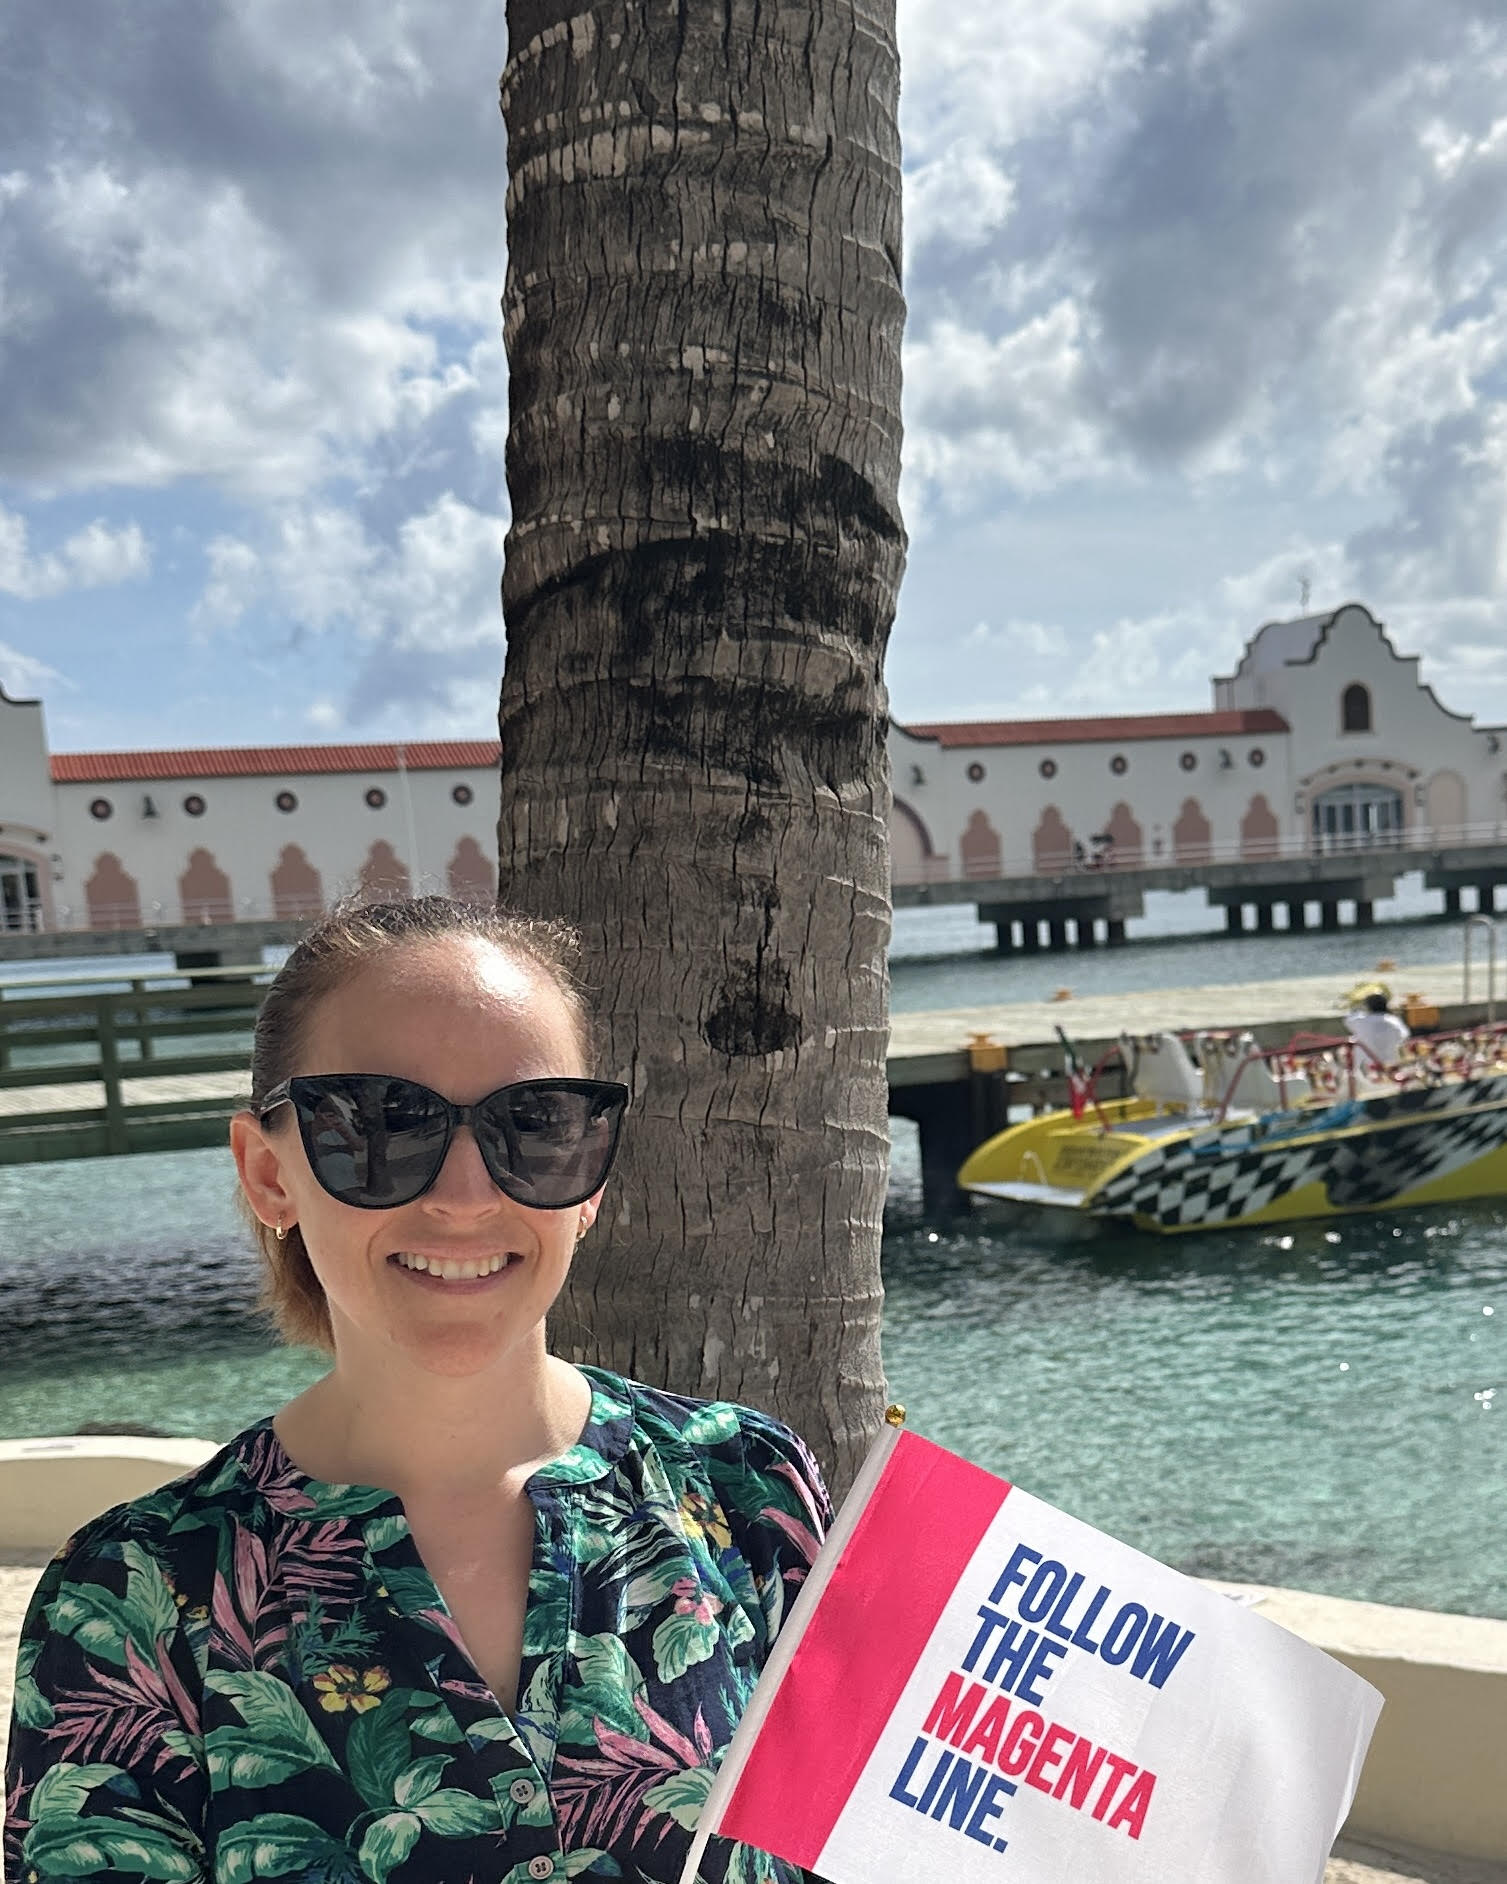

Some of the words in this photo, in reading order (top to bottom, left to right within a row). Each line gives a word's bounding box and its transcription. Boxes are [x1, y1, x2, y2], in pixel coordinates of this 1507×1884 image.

[961, 1605, 1068, 1707] THE
[988, 1543, 1195, 1690] FOLLOW
[889, 1736, 1018, 1853] LINE.
[921, 1671, 1157, 1840] MAGENTA
